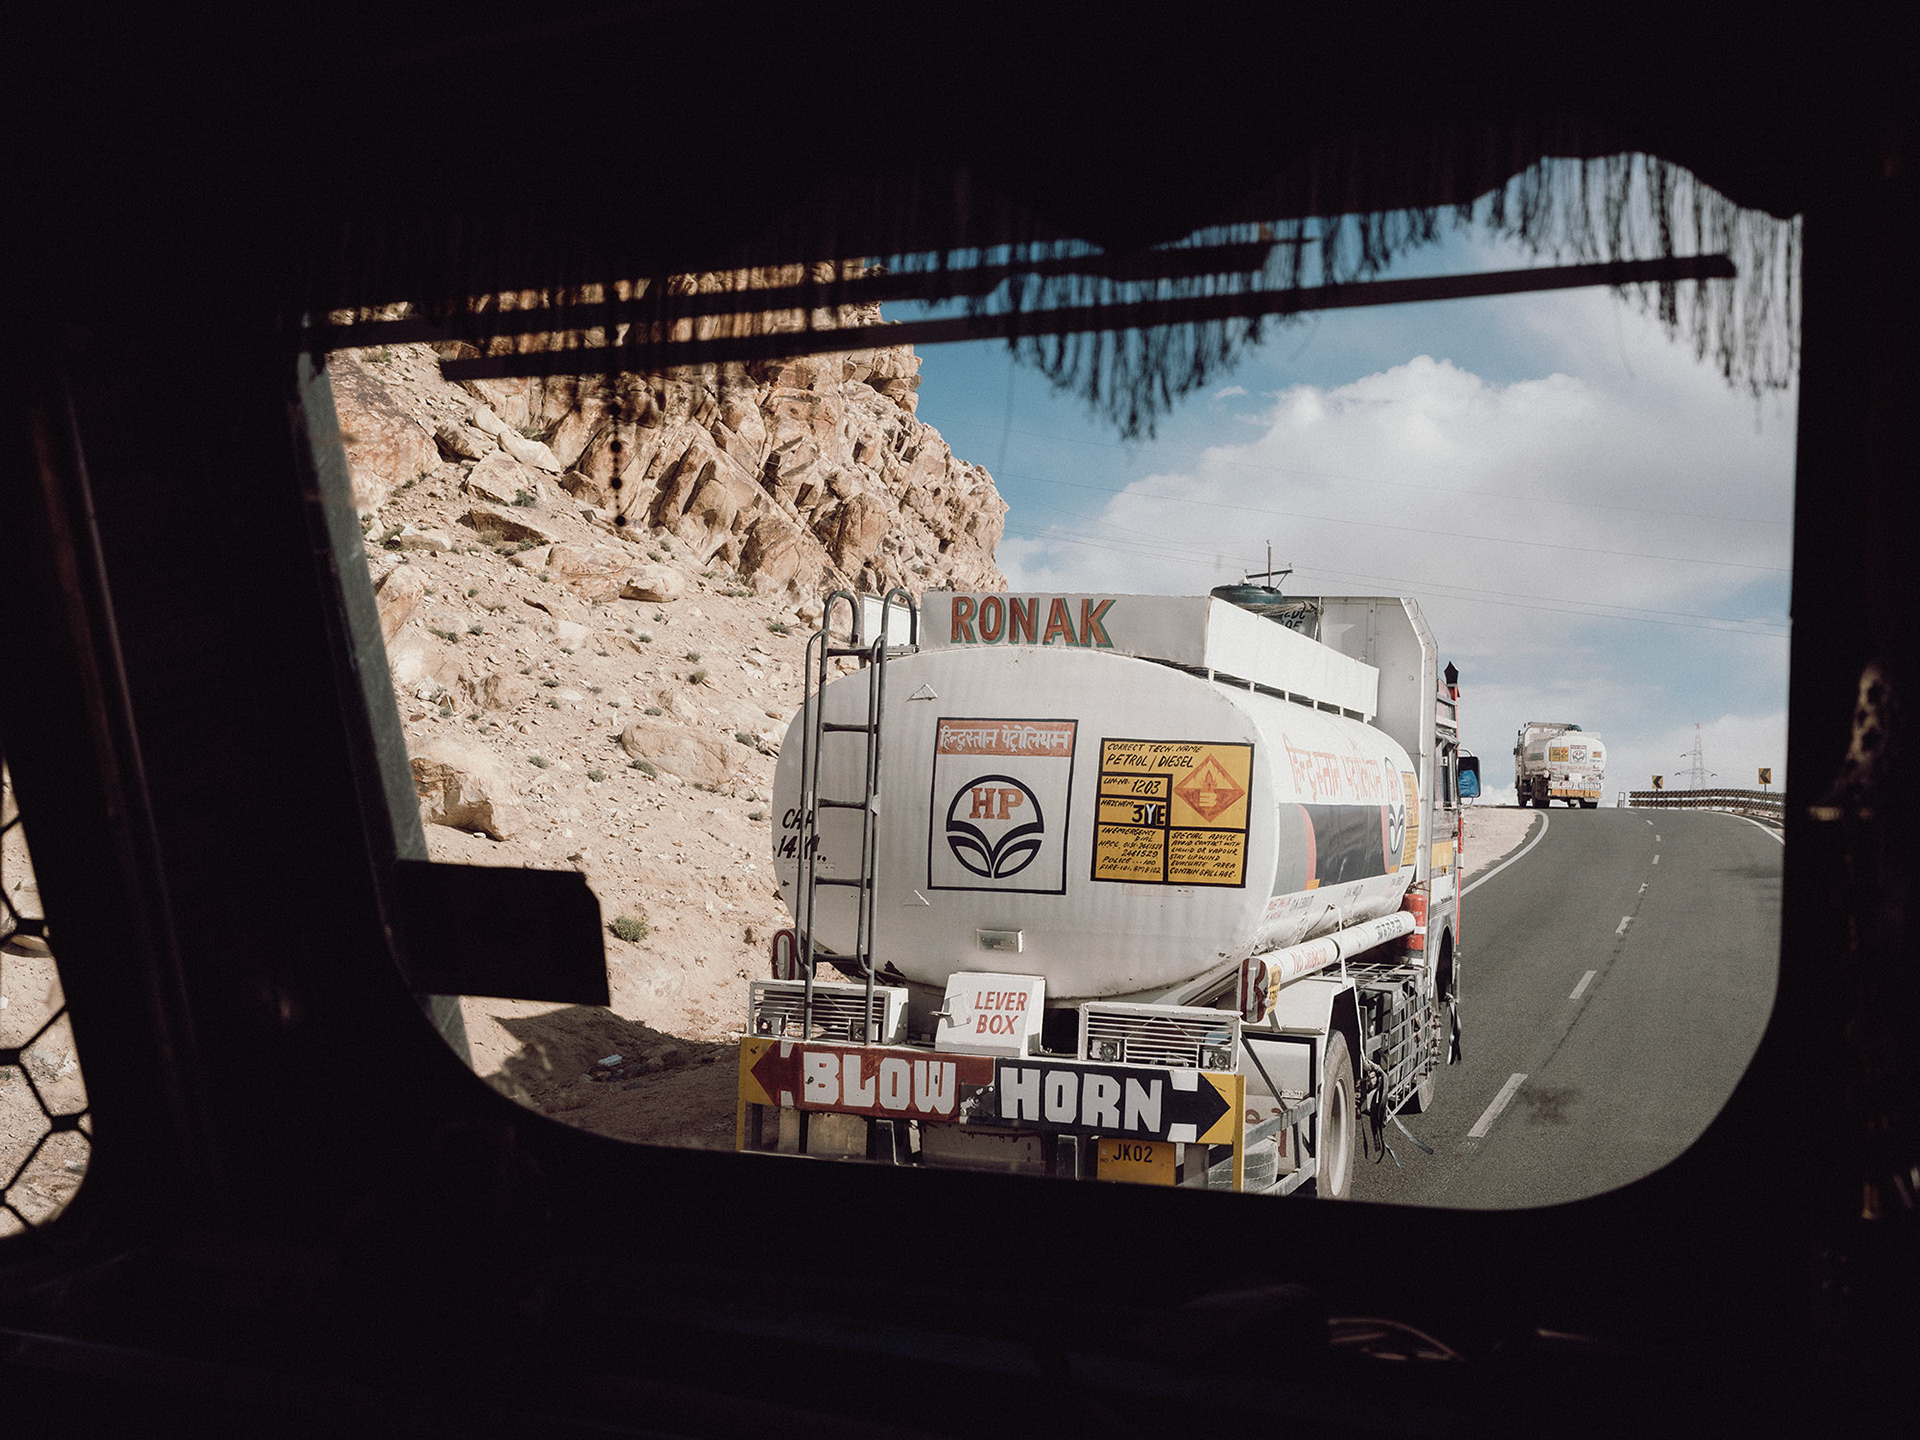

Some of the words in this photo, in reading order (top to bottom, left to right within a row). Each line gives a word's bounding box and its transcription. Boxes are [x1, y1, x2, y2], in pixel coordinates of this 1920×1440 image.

[950, 596, 1117, 648] RONAK
[1107, 743, 1145, 751] CORRECT
[1131, 779, 1161, 795] 1203
[969, 787, 1024, 819] HP
[1131, 804, 1166, 825] 3YE
[974, 991, 1027, 1011] LEVER
[975, 1014, 1018, 1035] BOX
[803, 1051, 957, 1115] BLOW
[999, 1066, 1163, 1133] HORN
[1113, 1143, 1152, 1163] JK02
